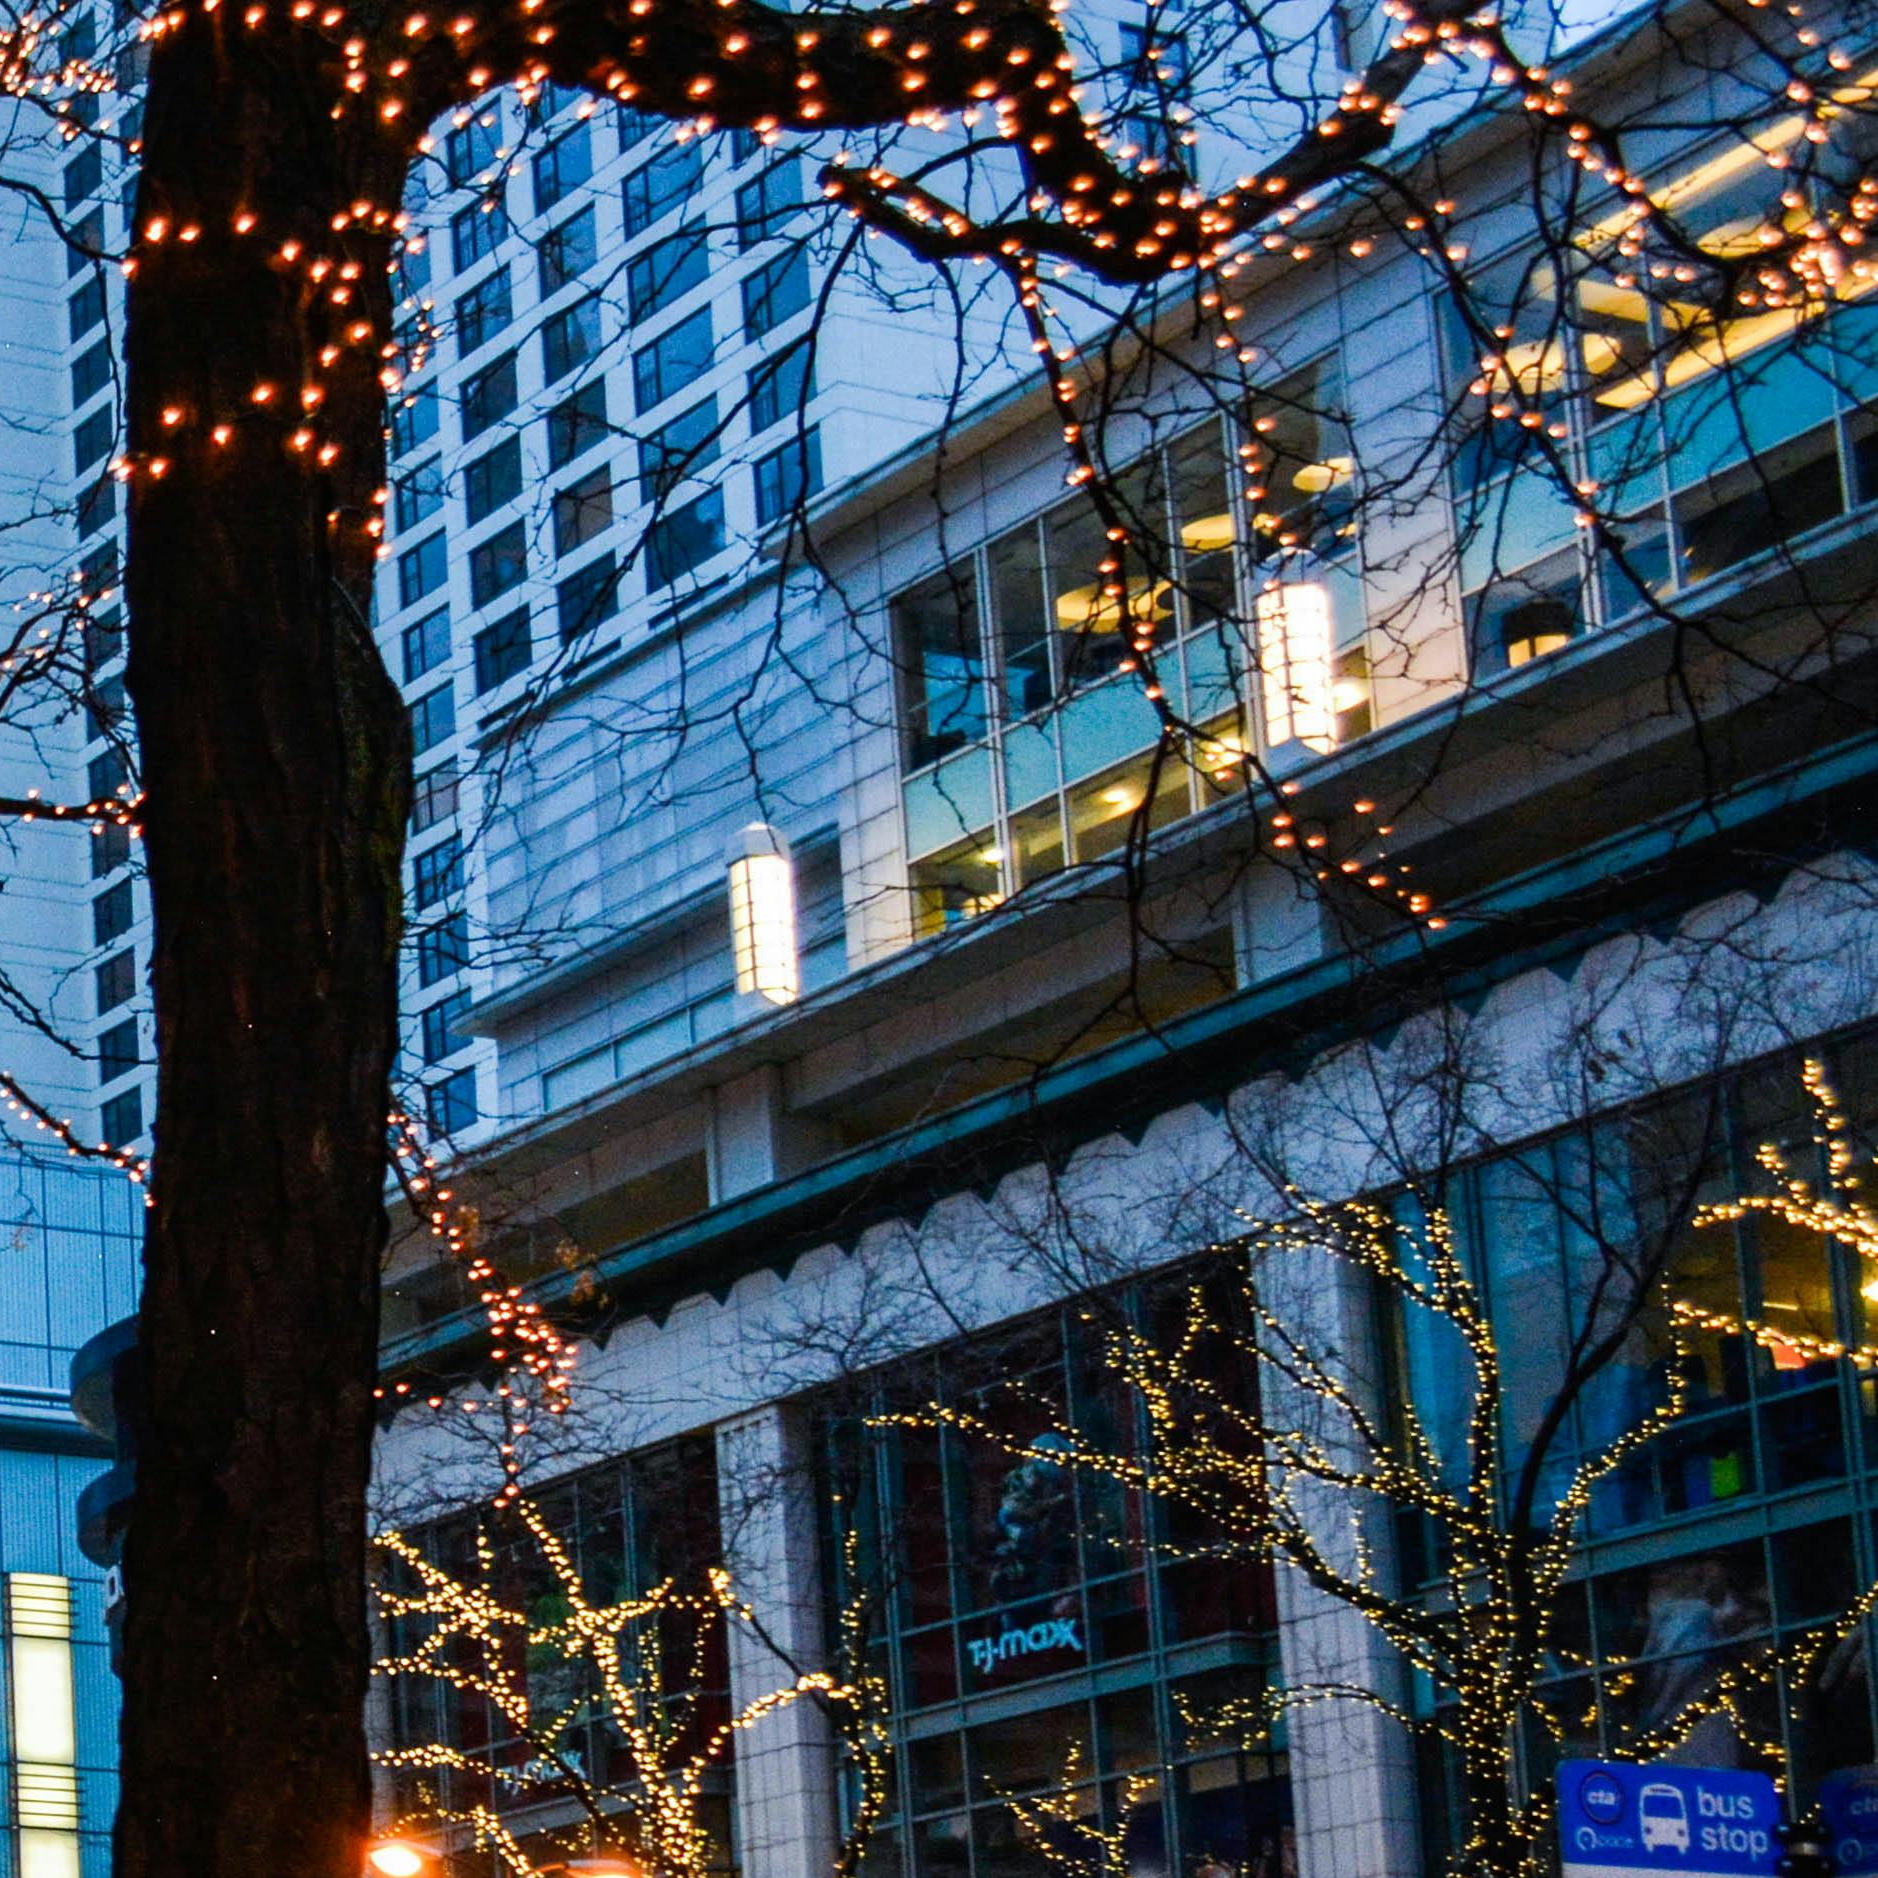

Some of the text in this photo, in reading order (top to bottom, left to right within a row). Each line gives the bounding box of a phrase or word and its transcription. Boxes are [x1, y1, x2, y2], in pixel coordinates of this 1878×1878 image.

[1586, 1789, 1617, 1805] cta
[1696, 1785, 1755, 1819] bus
[1701, 1824, 1769, 1862] stop
